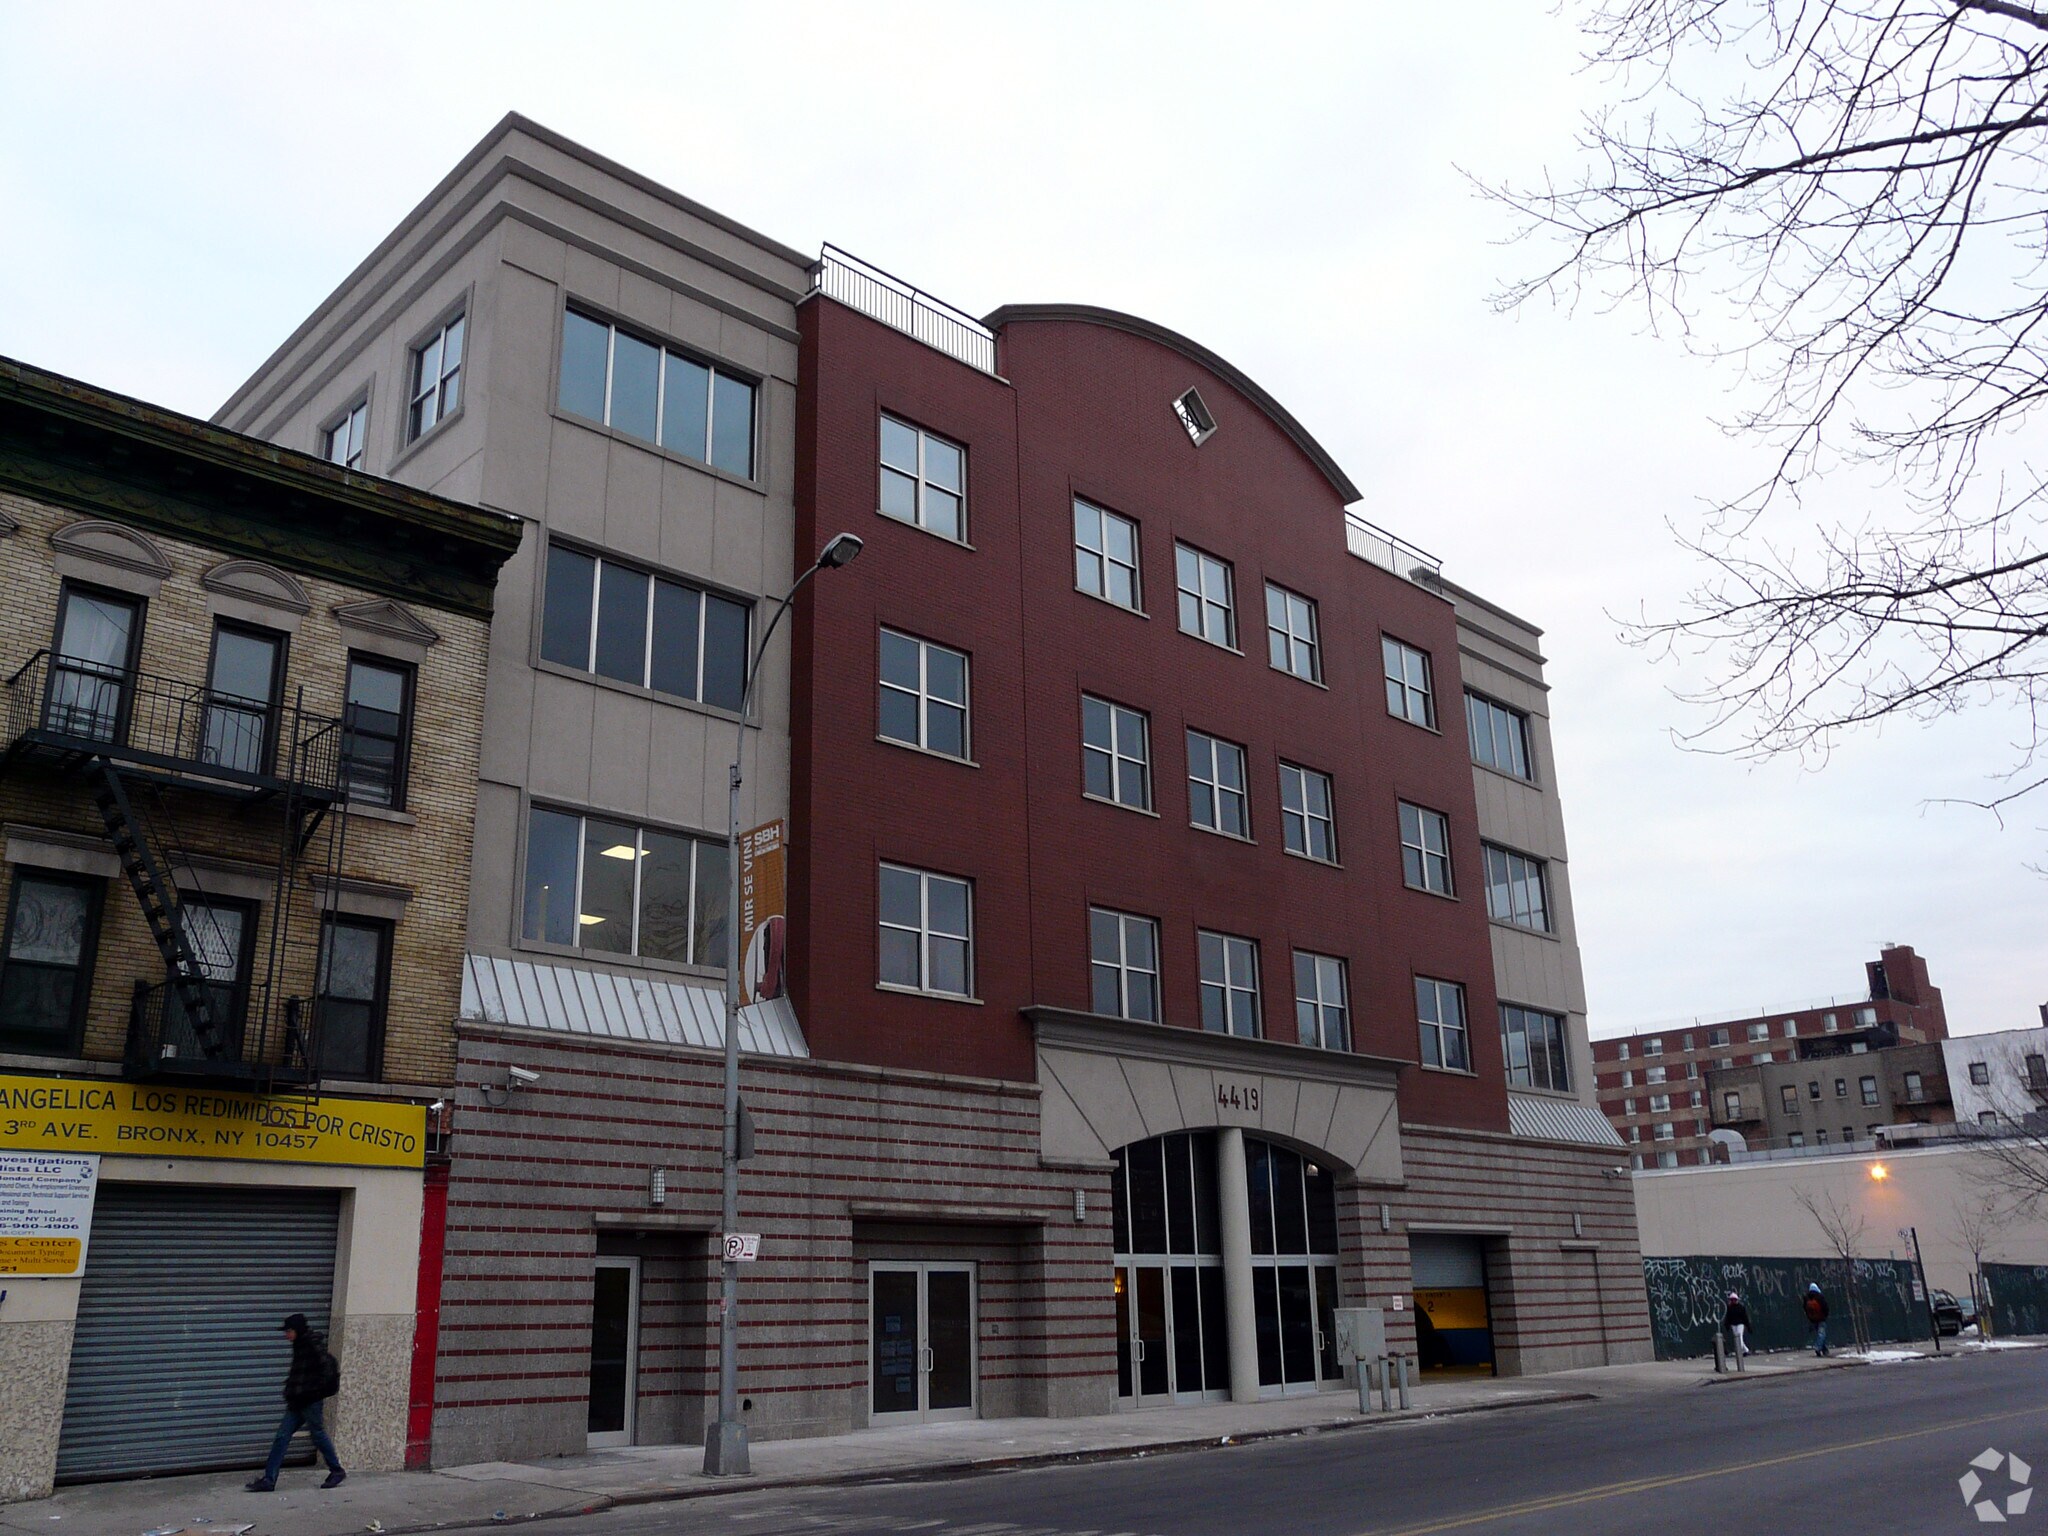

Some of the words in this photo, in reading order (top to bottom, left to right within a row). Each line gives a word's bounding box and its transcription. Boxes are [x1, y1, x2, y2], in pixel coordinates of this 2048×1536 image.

[755, 825, 780, 846] SBH
[743, 836, 753, 872] VINI
[744, 875, 754, 896] SE
[744, 899, 754, 932] MIR
[1218, 1084, 1259, 1111] 4419
[132, 1091, 177, 1113] LOS
[184, 1094, 297, 1127] REDIMIDOS
[306, 1112, 344, 1137] POR
[349, 1122, 416, 1153] CRISTO
[42, 1122, 98, 1139] AVE.
[117, 1125, 205, 1145] BRONX,
[215, 1130, 244, 1146] NY
[255, 1133, 319, 1150] 10457
[37, 1176, 81, 1184] Company
[14, 1239, 76, 1247] Center
